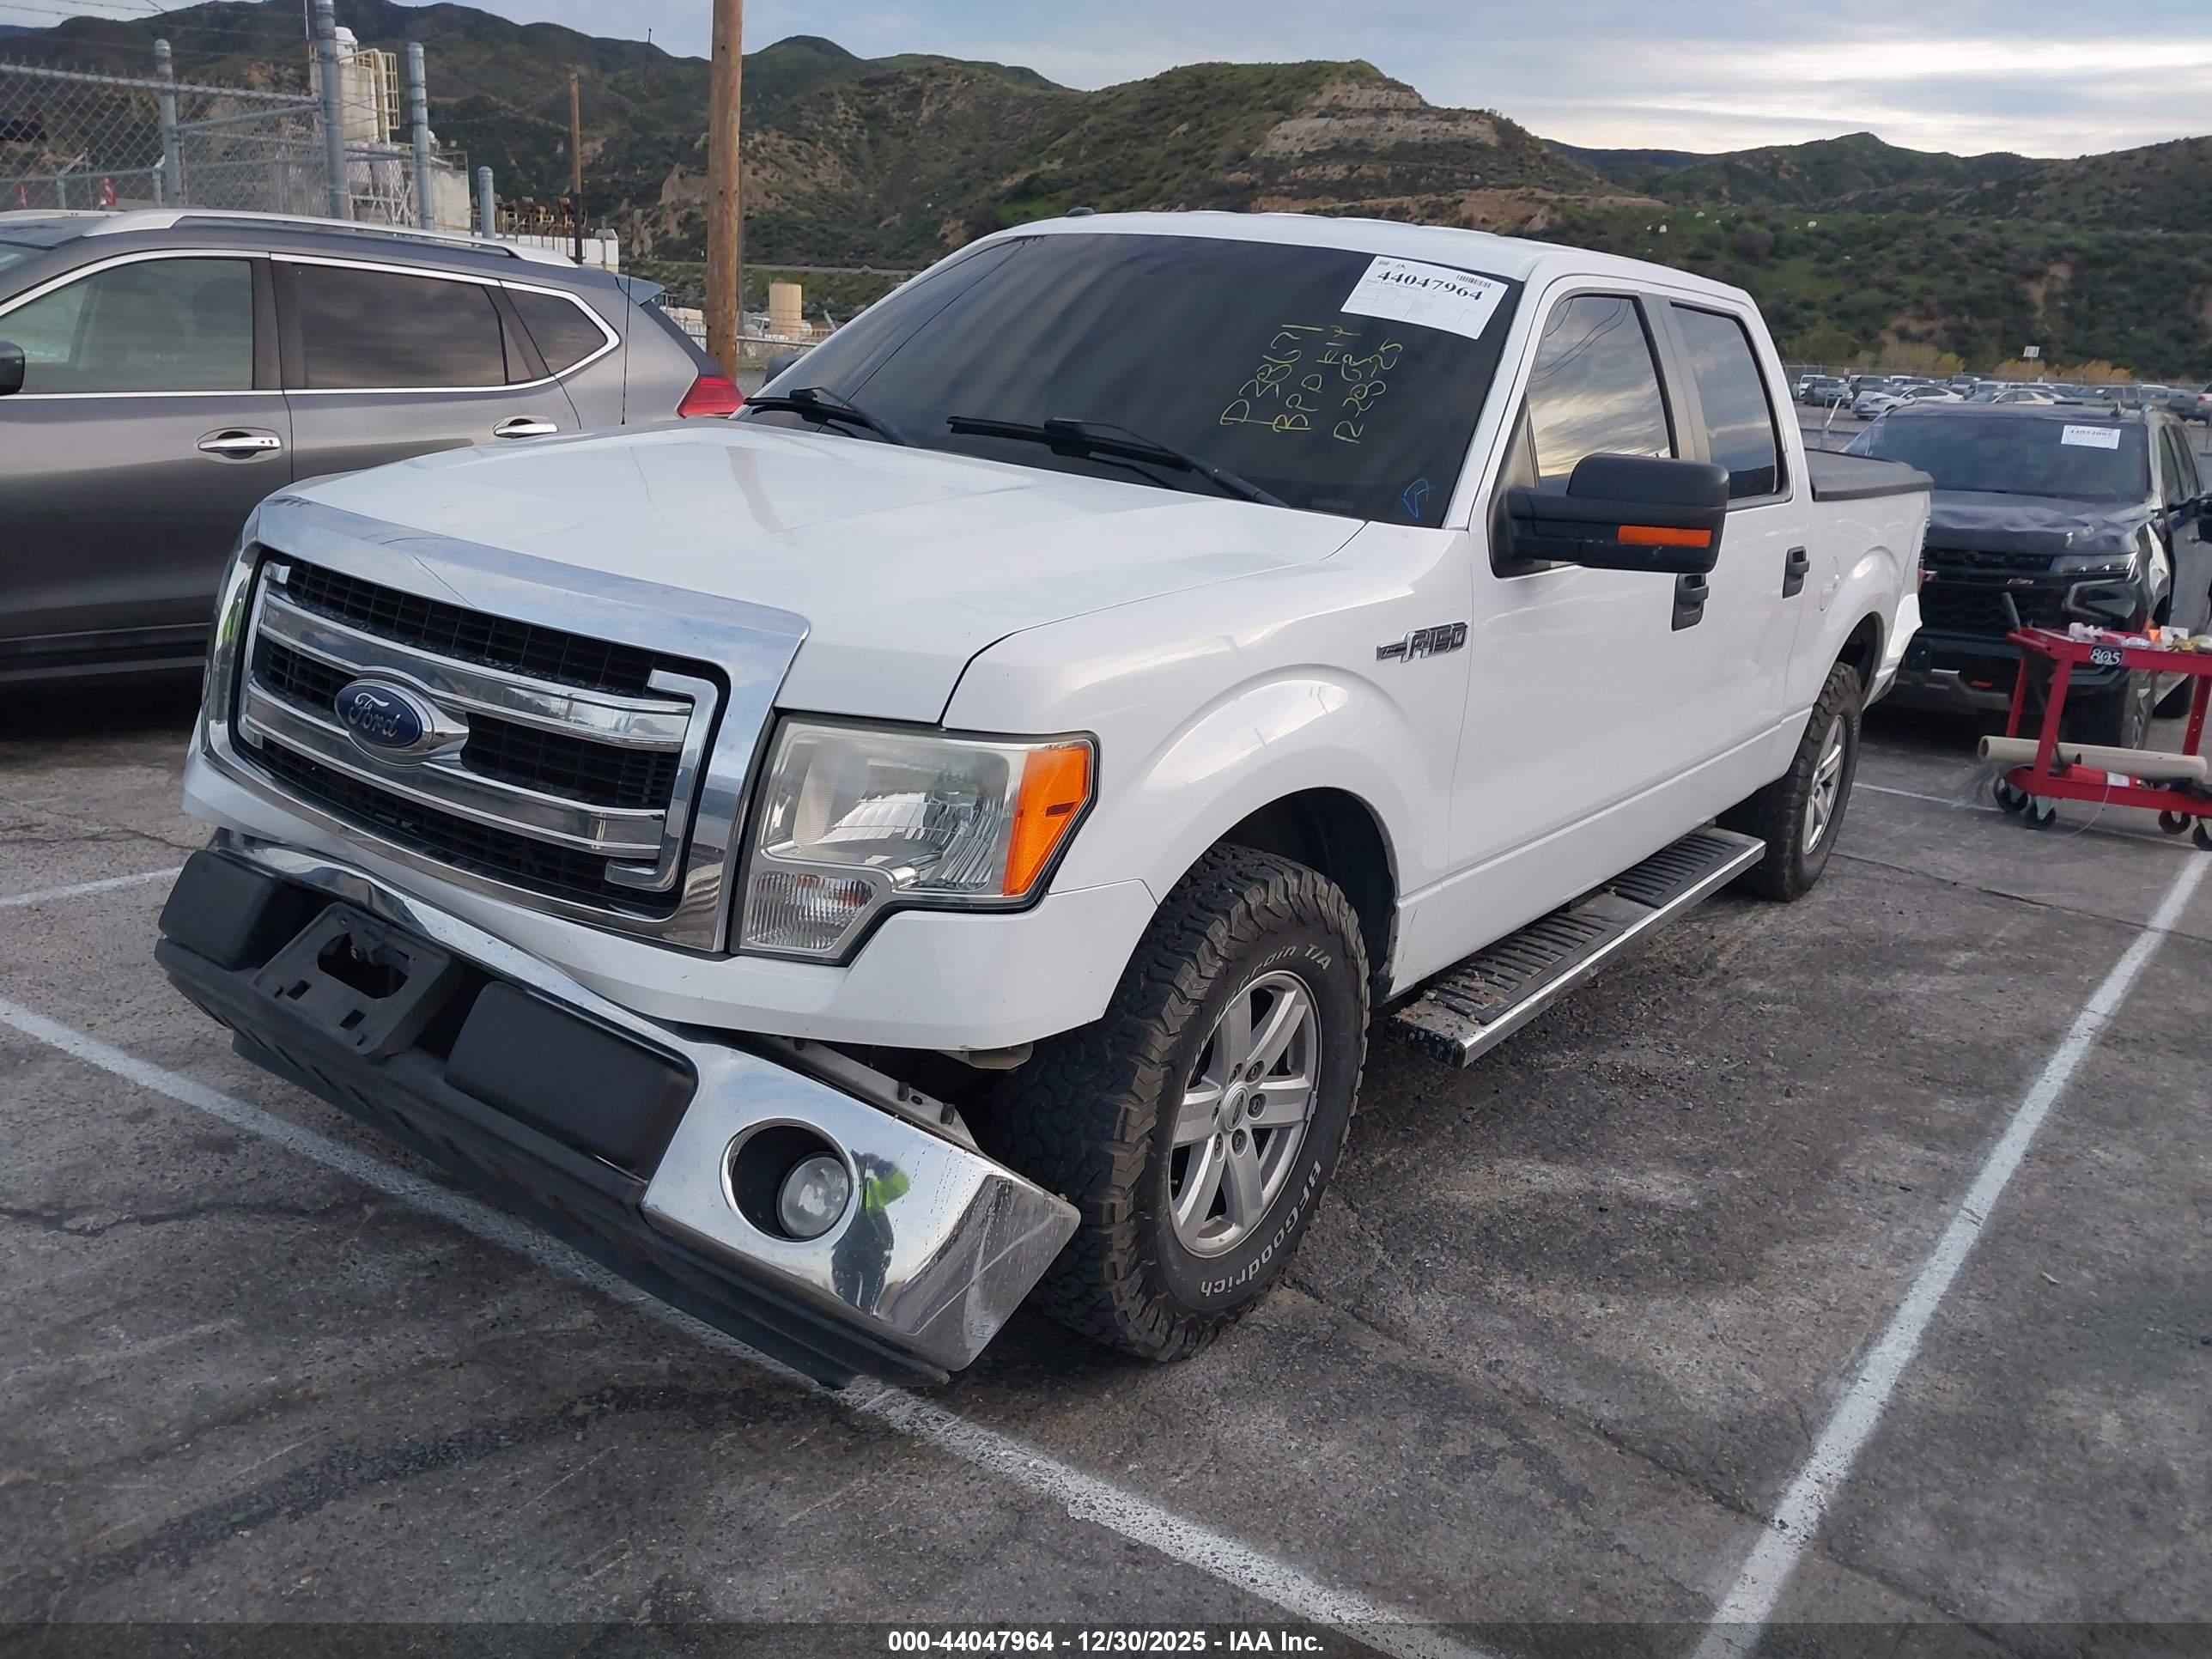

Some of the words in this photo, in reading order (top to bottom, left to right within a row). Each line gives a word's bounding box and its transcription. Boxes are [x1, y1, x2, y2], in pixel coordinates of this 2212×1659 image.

[1376, 270, 1484, 301] 44047964
[2089, 647, 2122, 666] 805
[348, 692, 402, 738] Ford
[1304, 943, 1332, 971] T/A
[1200, 1159, 1322, 1297] BFGoodrich
